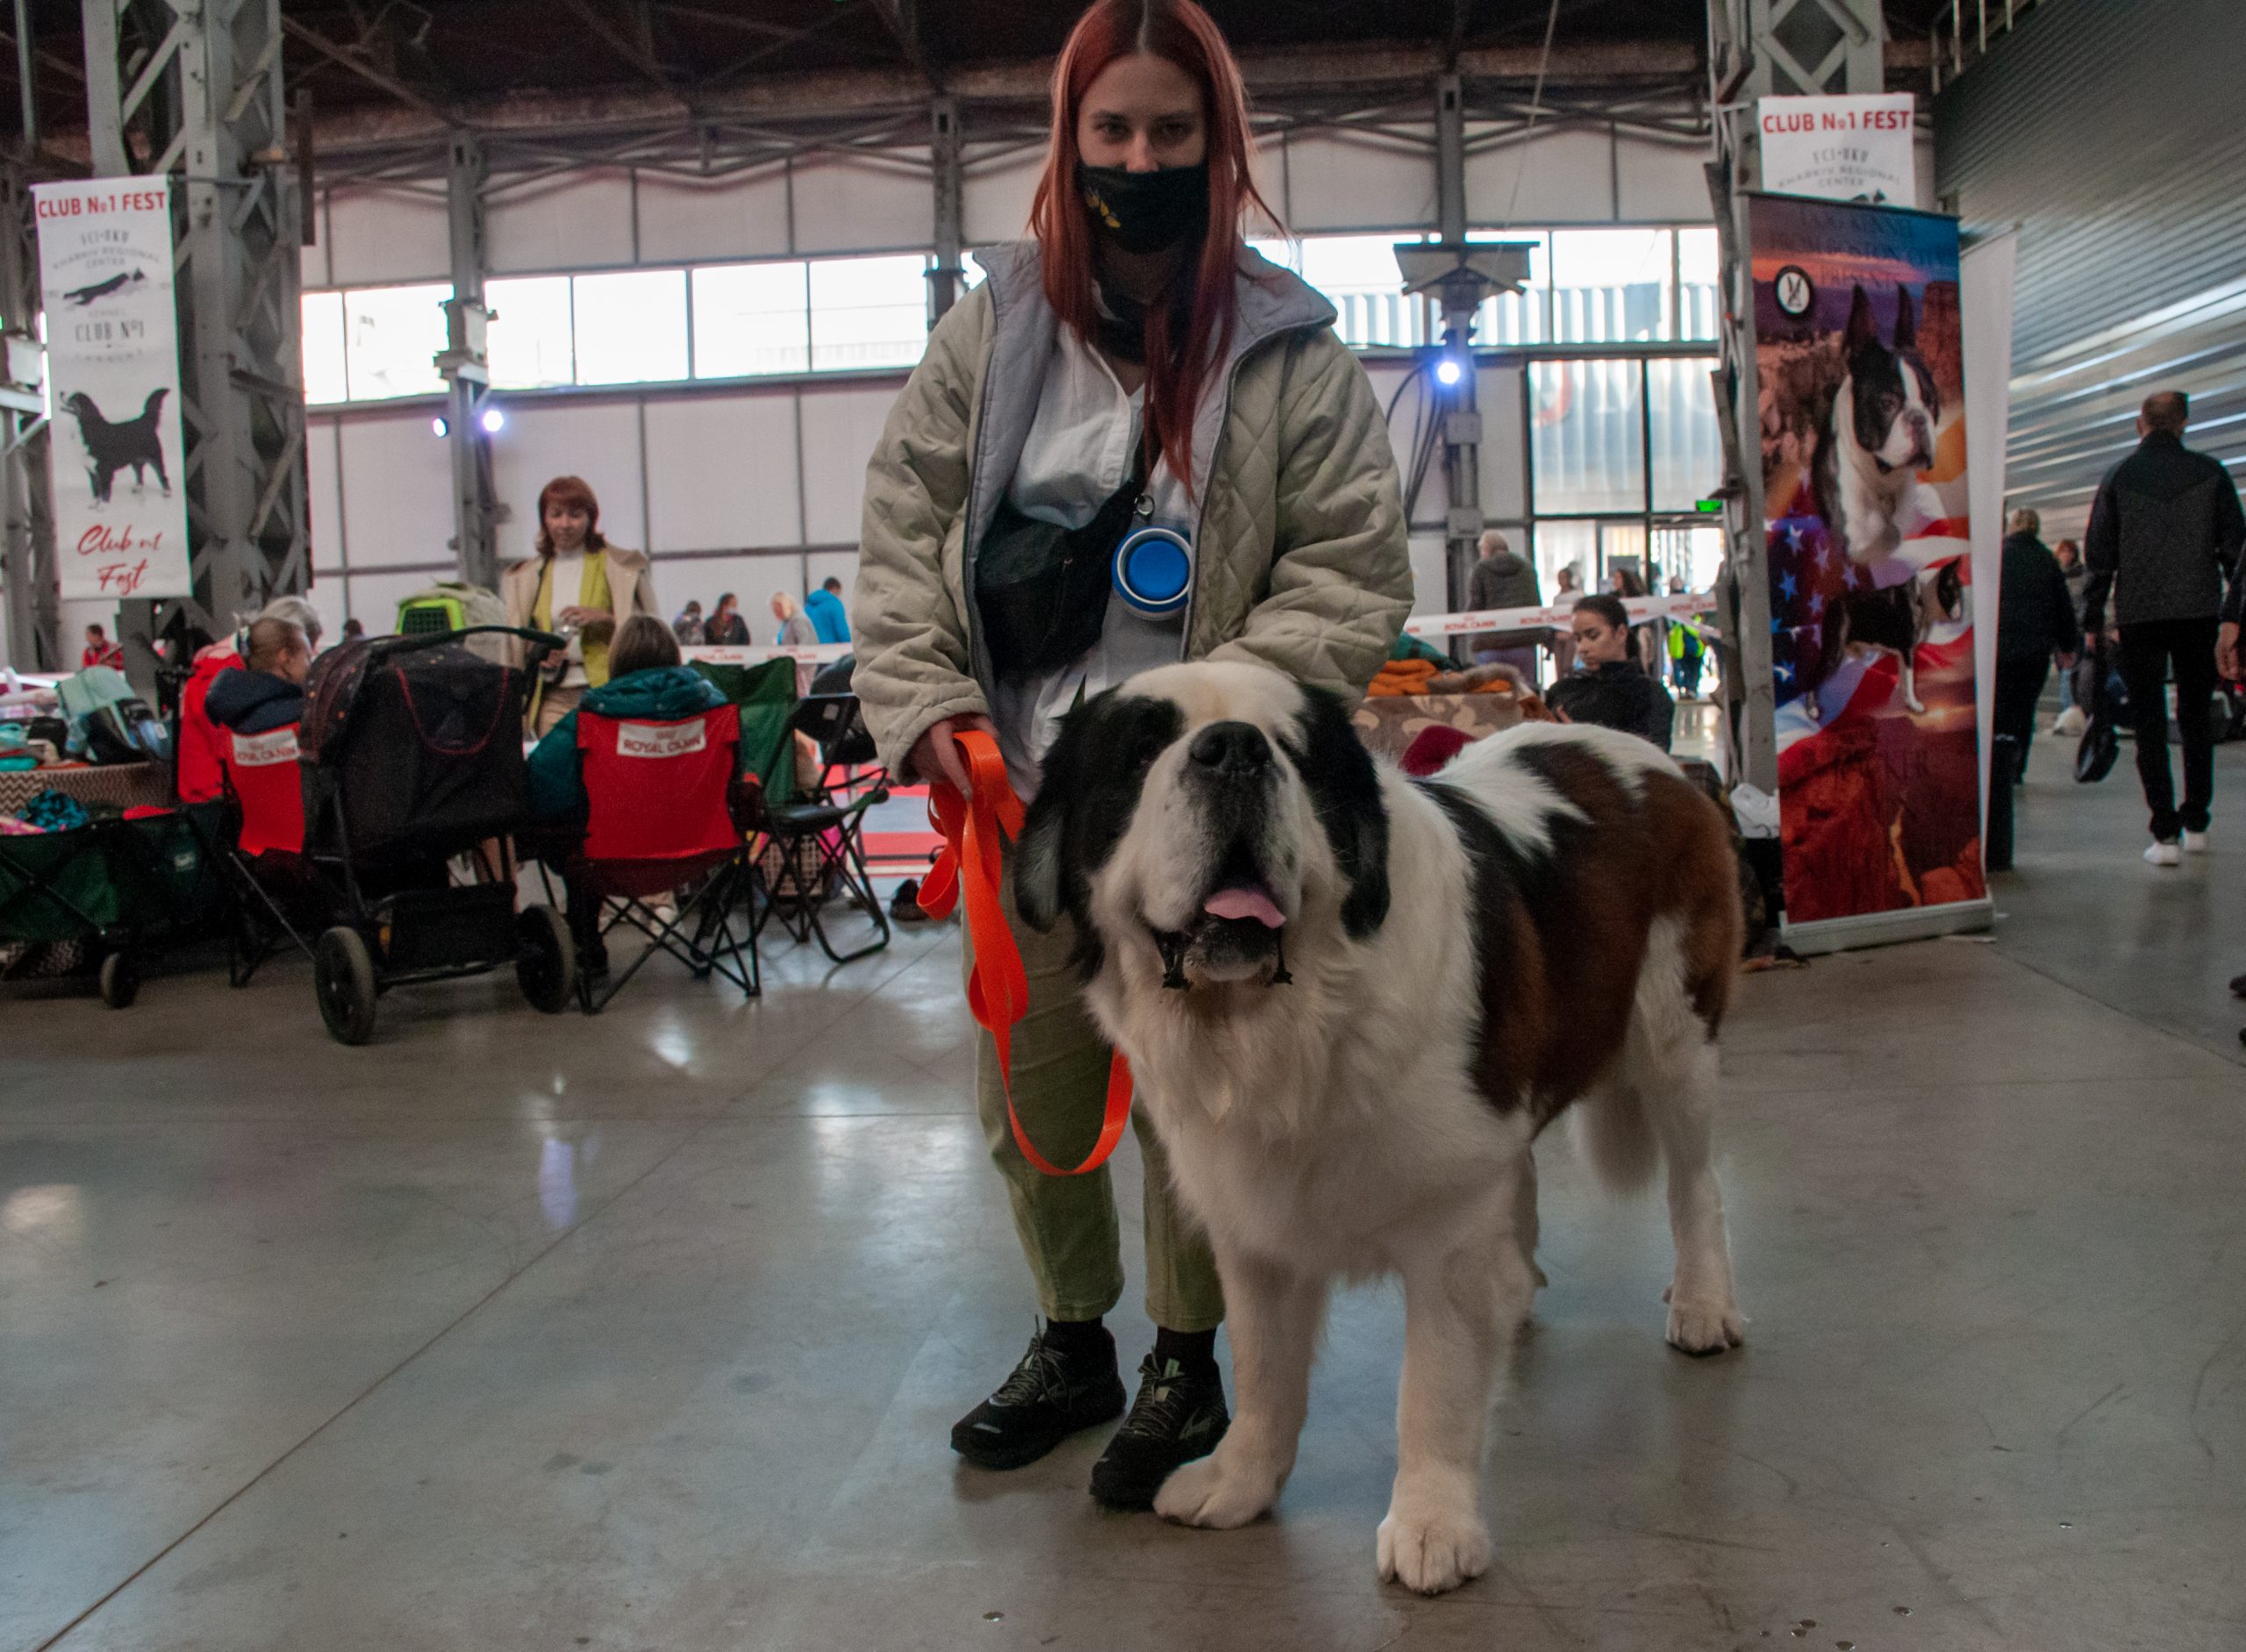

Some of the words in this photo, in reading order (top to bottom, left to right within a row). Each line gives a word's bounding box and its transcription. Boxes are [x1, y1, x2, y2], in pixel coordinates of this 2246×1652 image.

[1763, 113, 1814, 133] CLUB
[1863, 110, 1910, 131] FEST
[39, 197, 81, 218] CLUB
[122, 191, 165, 211] FEST
[75, 322, 112, 342] CLUB
[77, 525, 132, 555] Club
[97, 559, 147, 596] Fest
